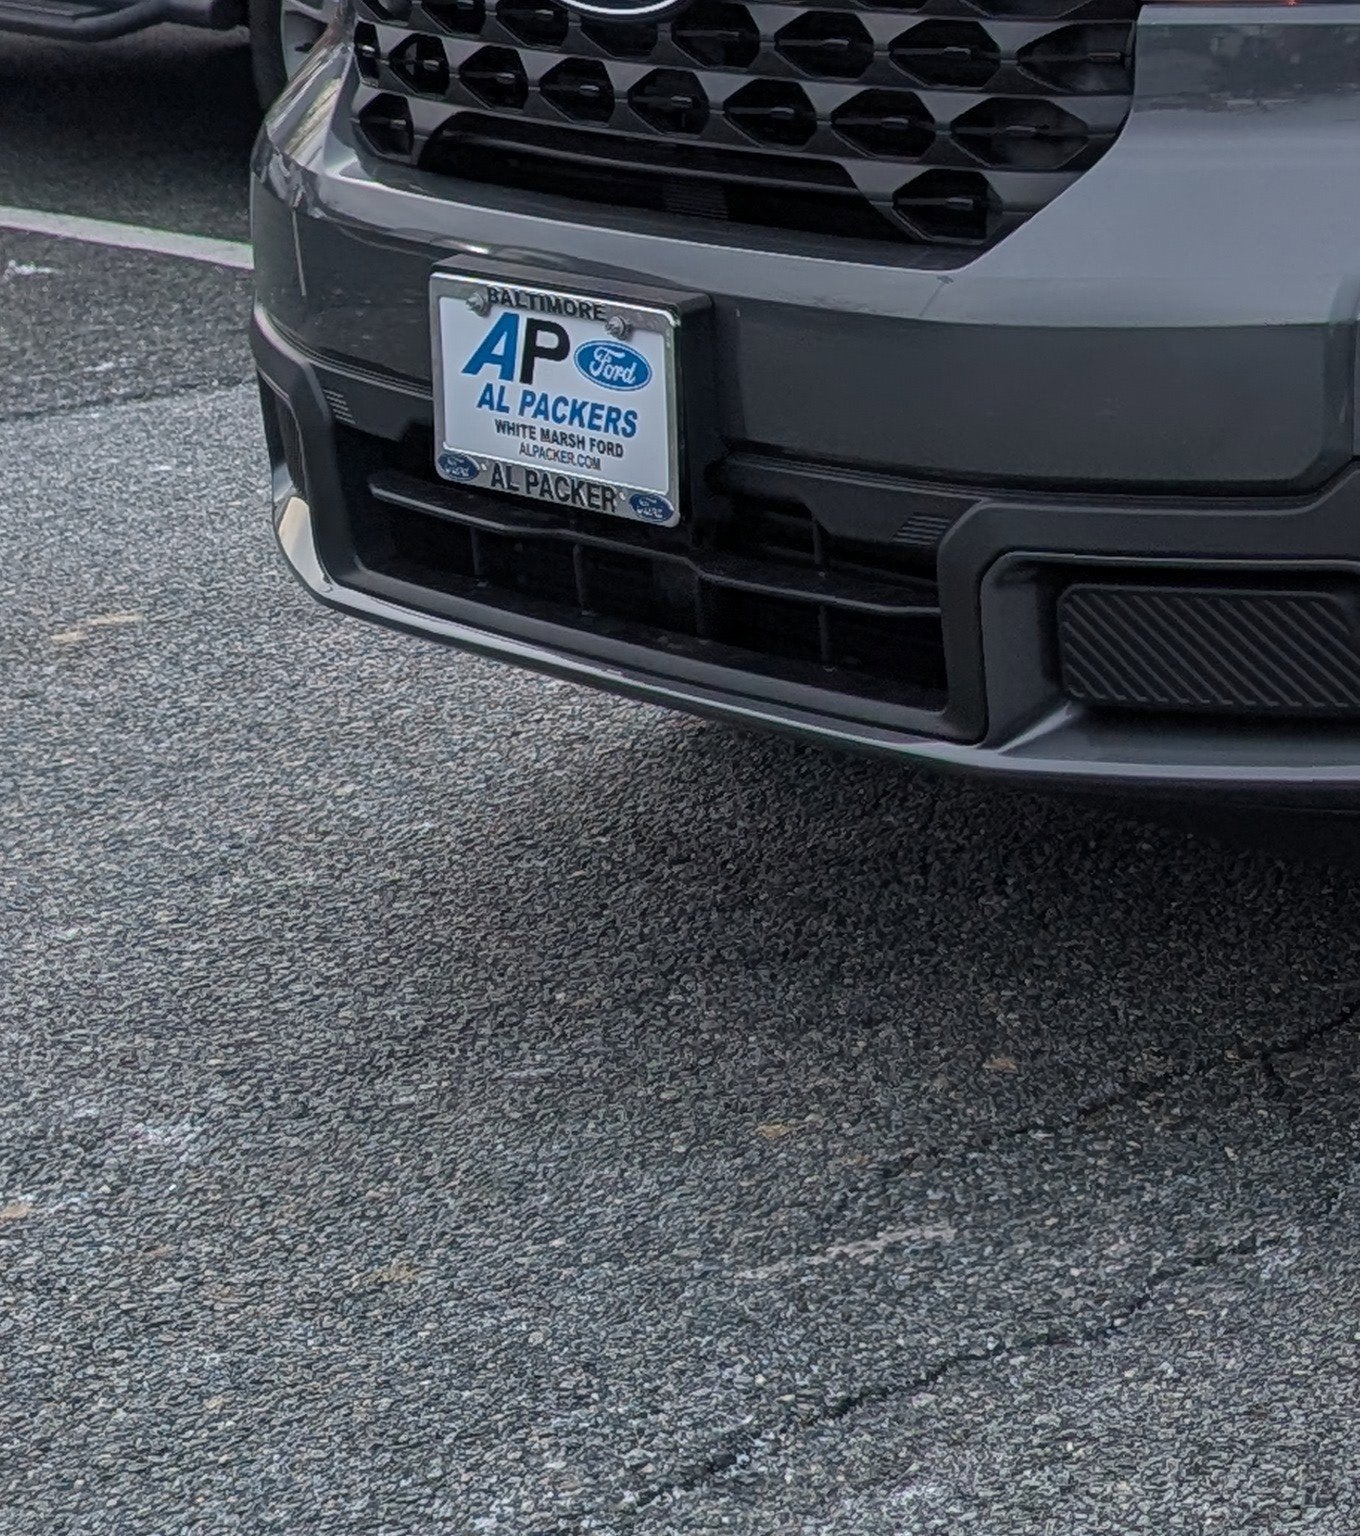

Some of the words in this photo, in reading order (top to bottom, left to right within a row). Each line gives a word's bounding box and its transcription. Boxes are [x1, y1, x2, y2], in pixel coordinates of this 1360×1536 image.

[488, 287, 606, 321] BALTIMORE
[461, 312, 571, 385] AP
[588, 346, 637, 383] Ford
[476, 383, 510, 413] AL
[518, 390, 638, 438] PACKERS
[494, 419, 536, 440] WHITE
[540, 428, 585, 450] MARSH
[589, 440, 624, 458] FORD
[519, 442, 602, 471] ALPACKER.COM
[490, 463, 519, 491] AL
[525, 471, 617, 511] PACKER
